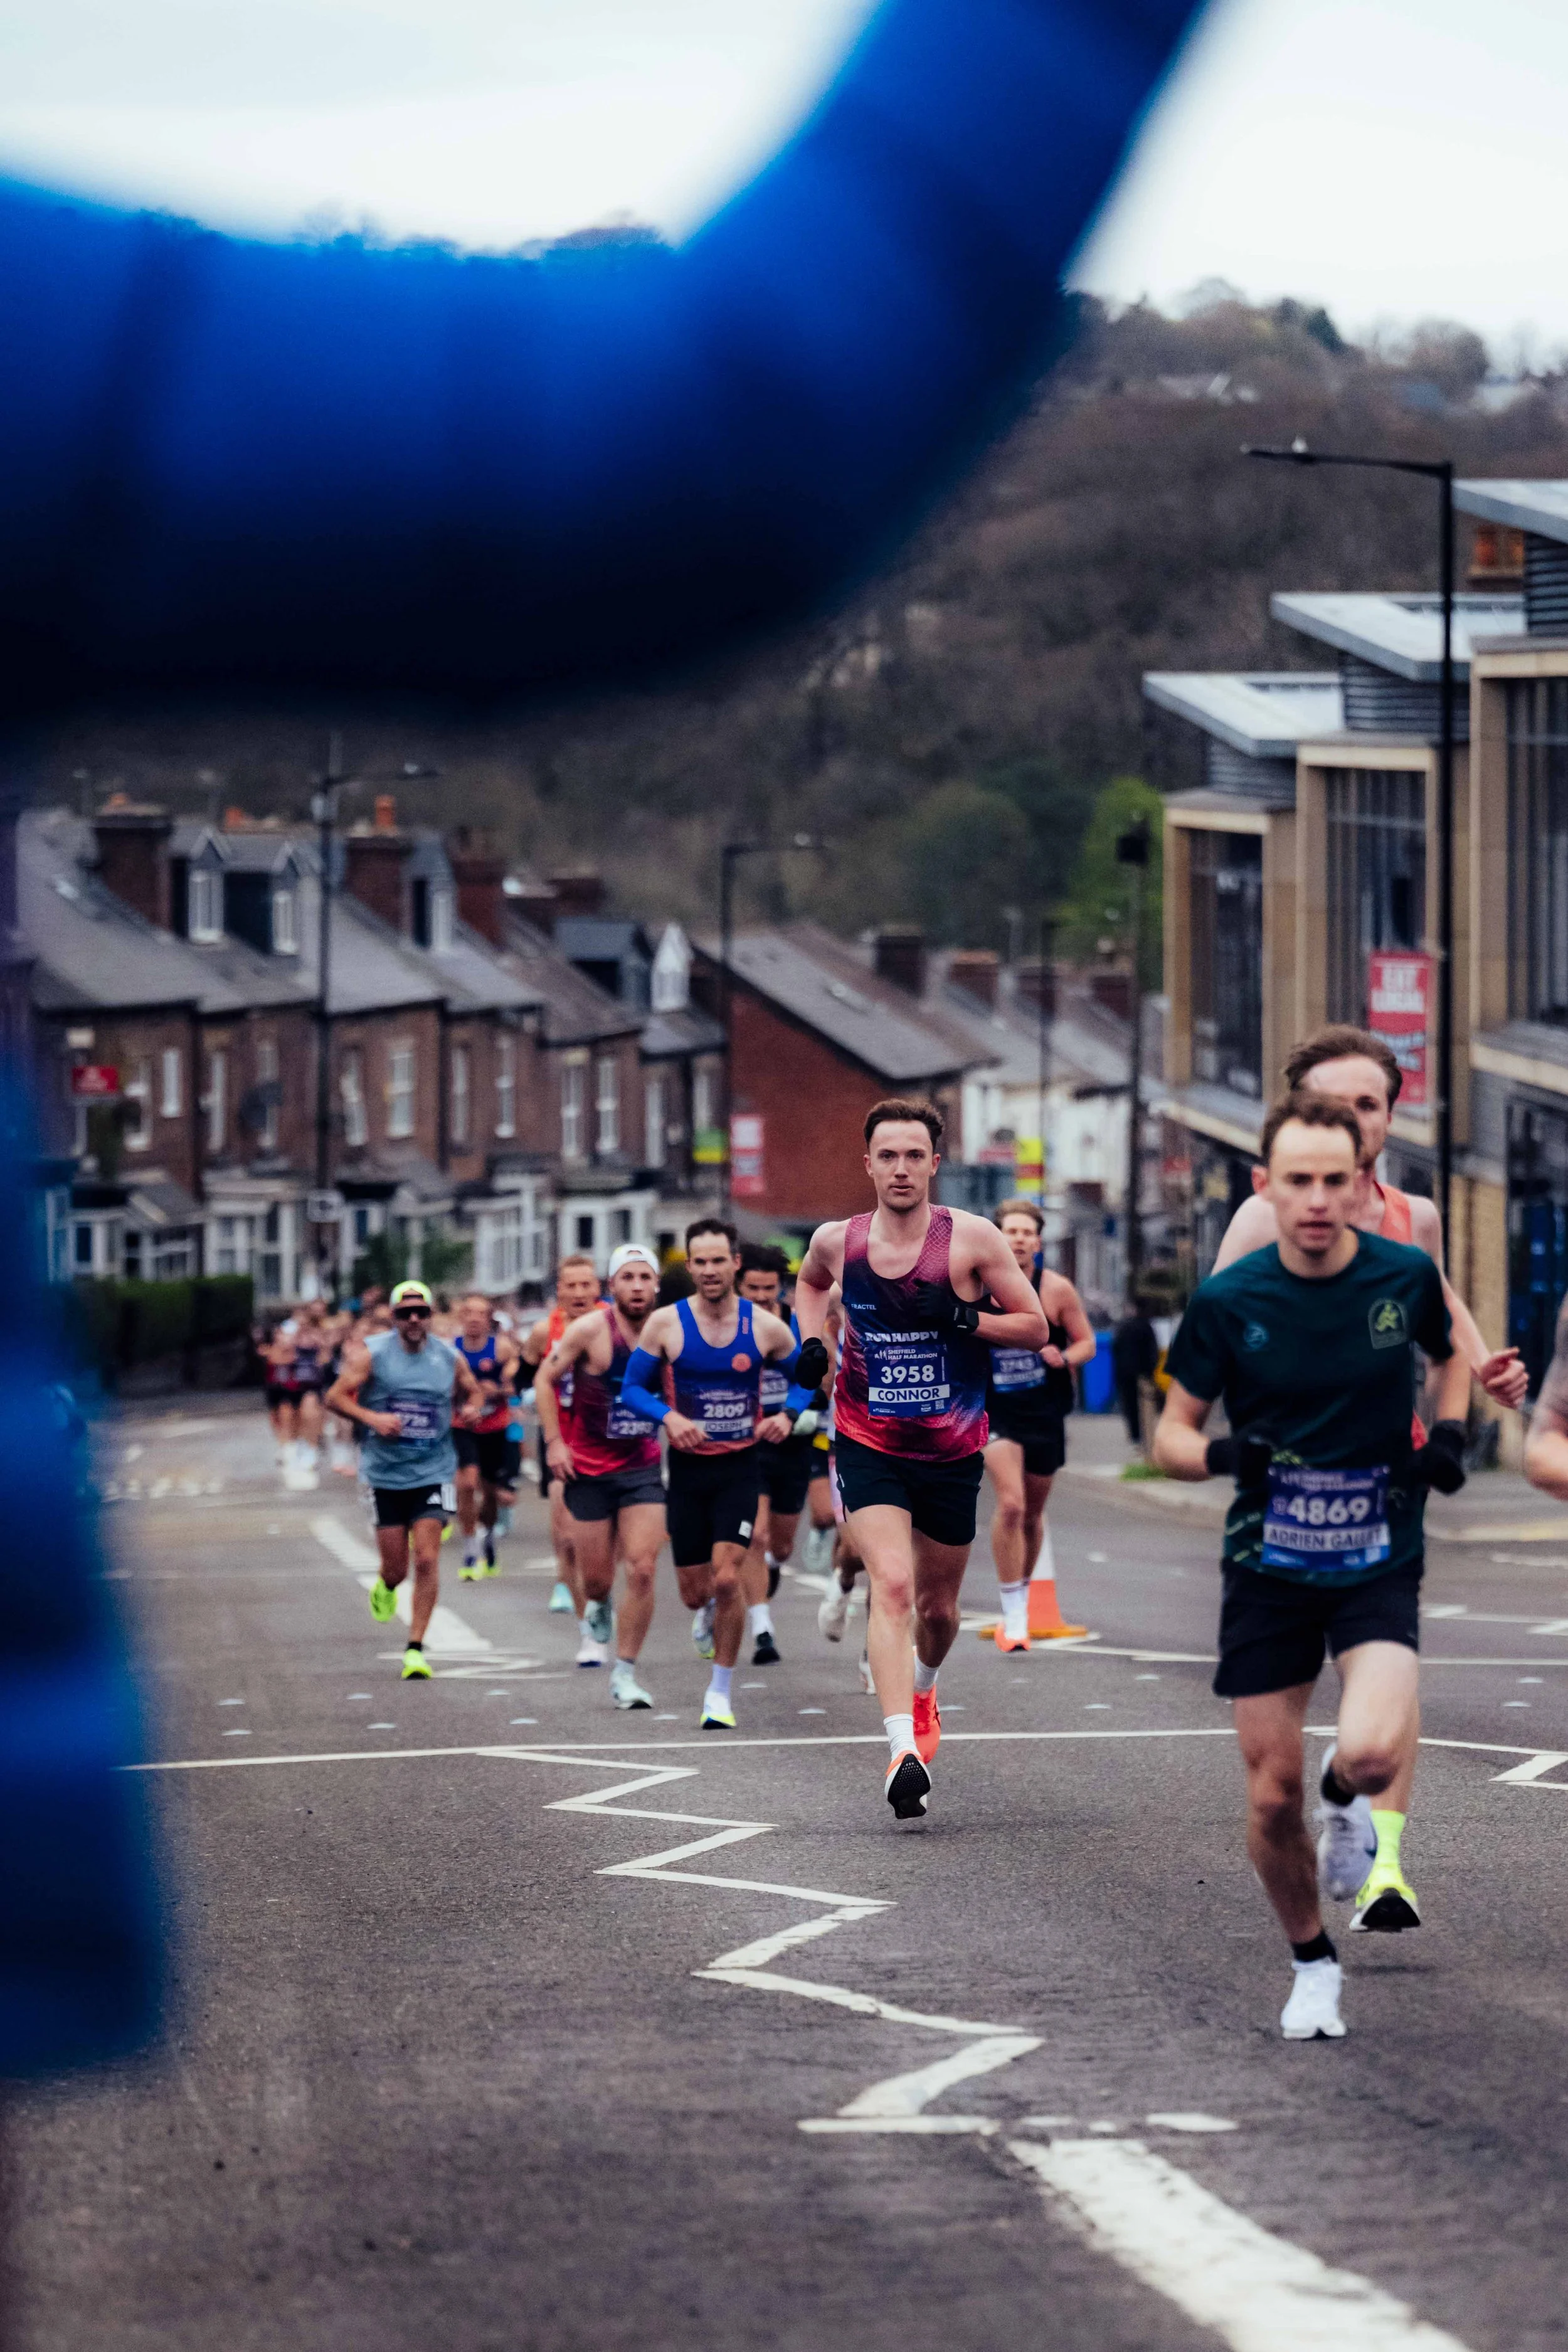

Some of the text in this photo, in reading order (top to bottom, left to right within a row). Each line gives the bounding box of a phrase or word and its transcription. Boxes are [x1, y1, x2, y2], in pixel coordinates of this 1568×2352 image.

[881, 1364, 935, 1384] 3958
[877, 1387, 940, 1402] CONNOR
[703, 1402, 745, 1418] 2809
[704, 1421, 742, 1431] JOSEPH
[1288, 1495, 1371, 1525] 4869
[1269, 1527, 1326, 1548] ADRIEN
